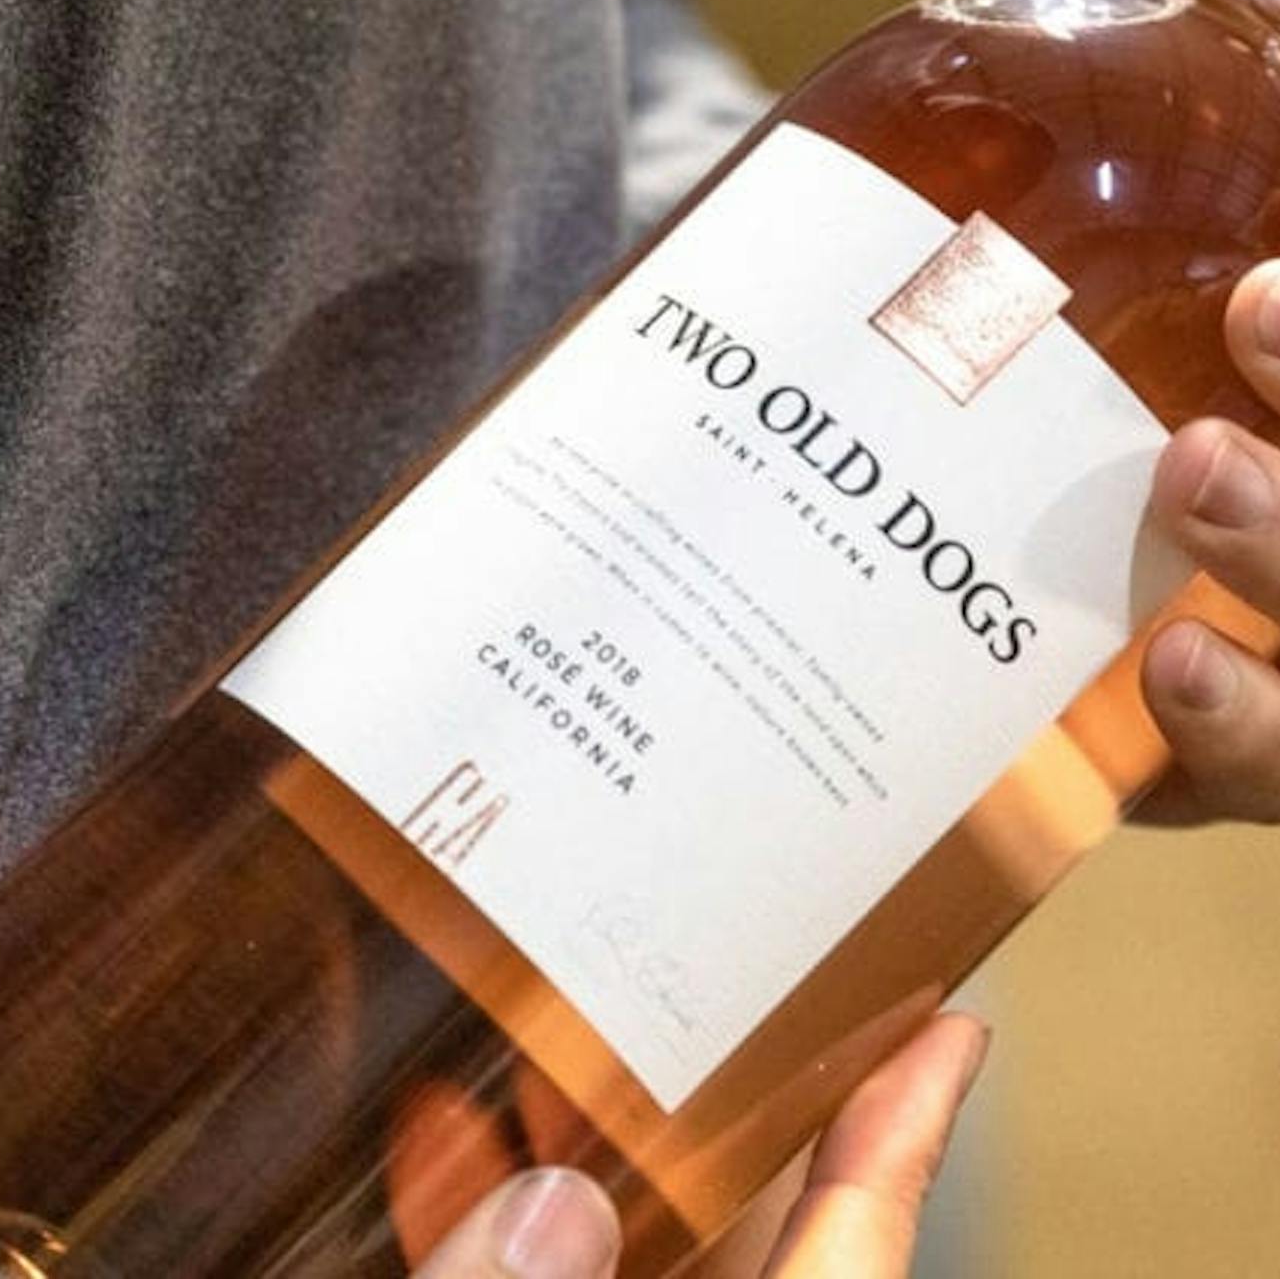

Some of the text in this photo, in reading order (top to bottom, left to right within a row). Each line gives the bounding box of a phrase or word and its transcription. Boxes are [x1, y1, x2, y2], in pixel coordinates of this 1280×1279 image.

[635, 294, 1037, 665] TWO OLD DOGS
[695, 414, 875, 581] SAINT HELENA
[477, 643, 636, 794] CALIFORNIA
[581, 630, 641, 687] 2018
[584, 684, 655, 755] WINE
